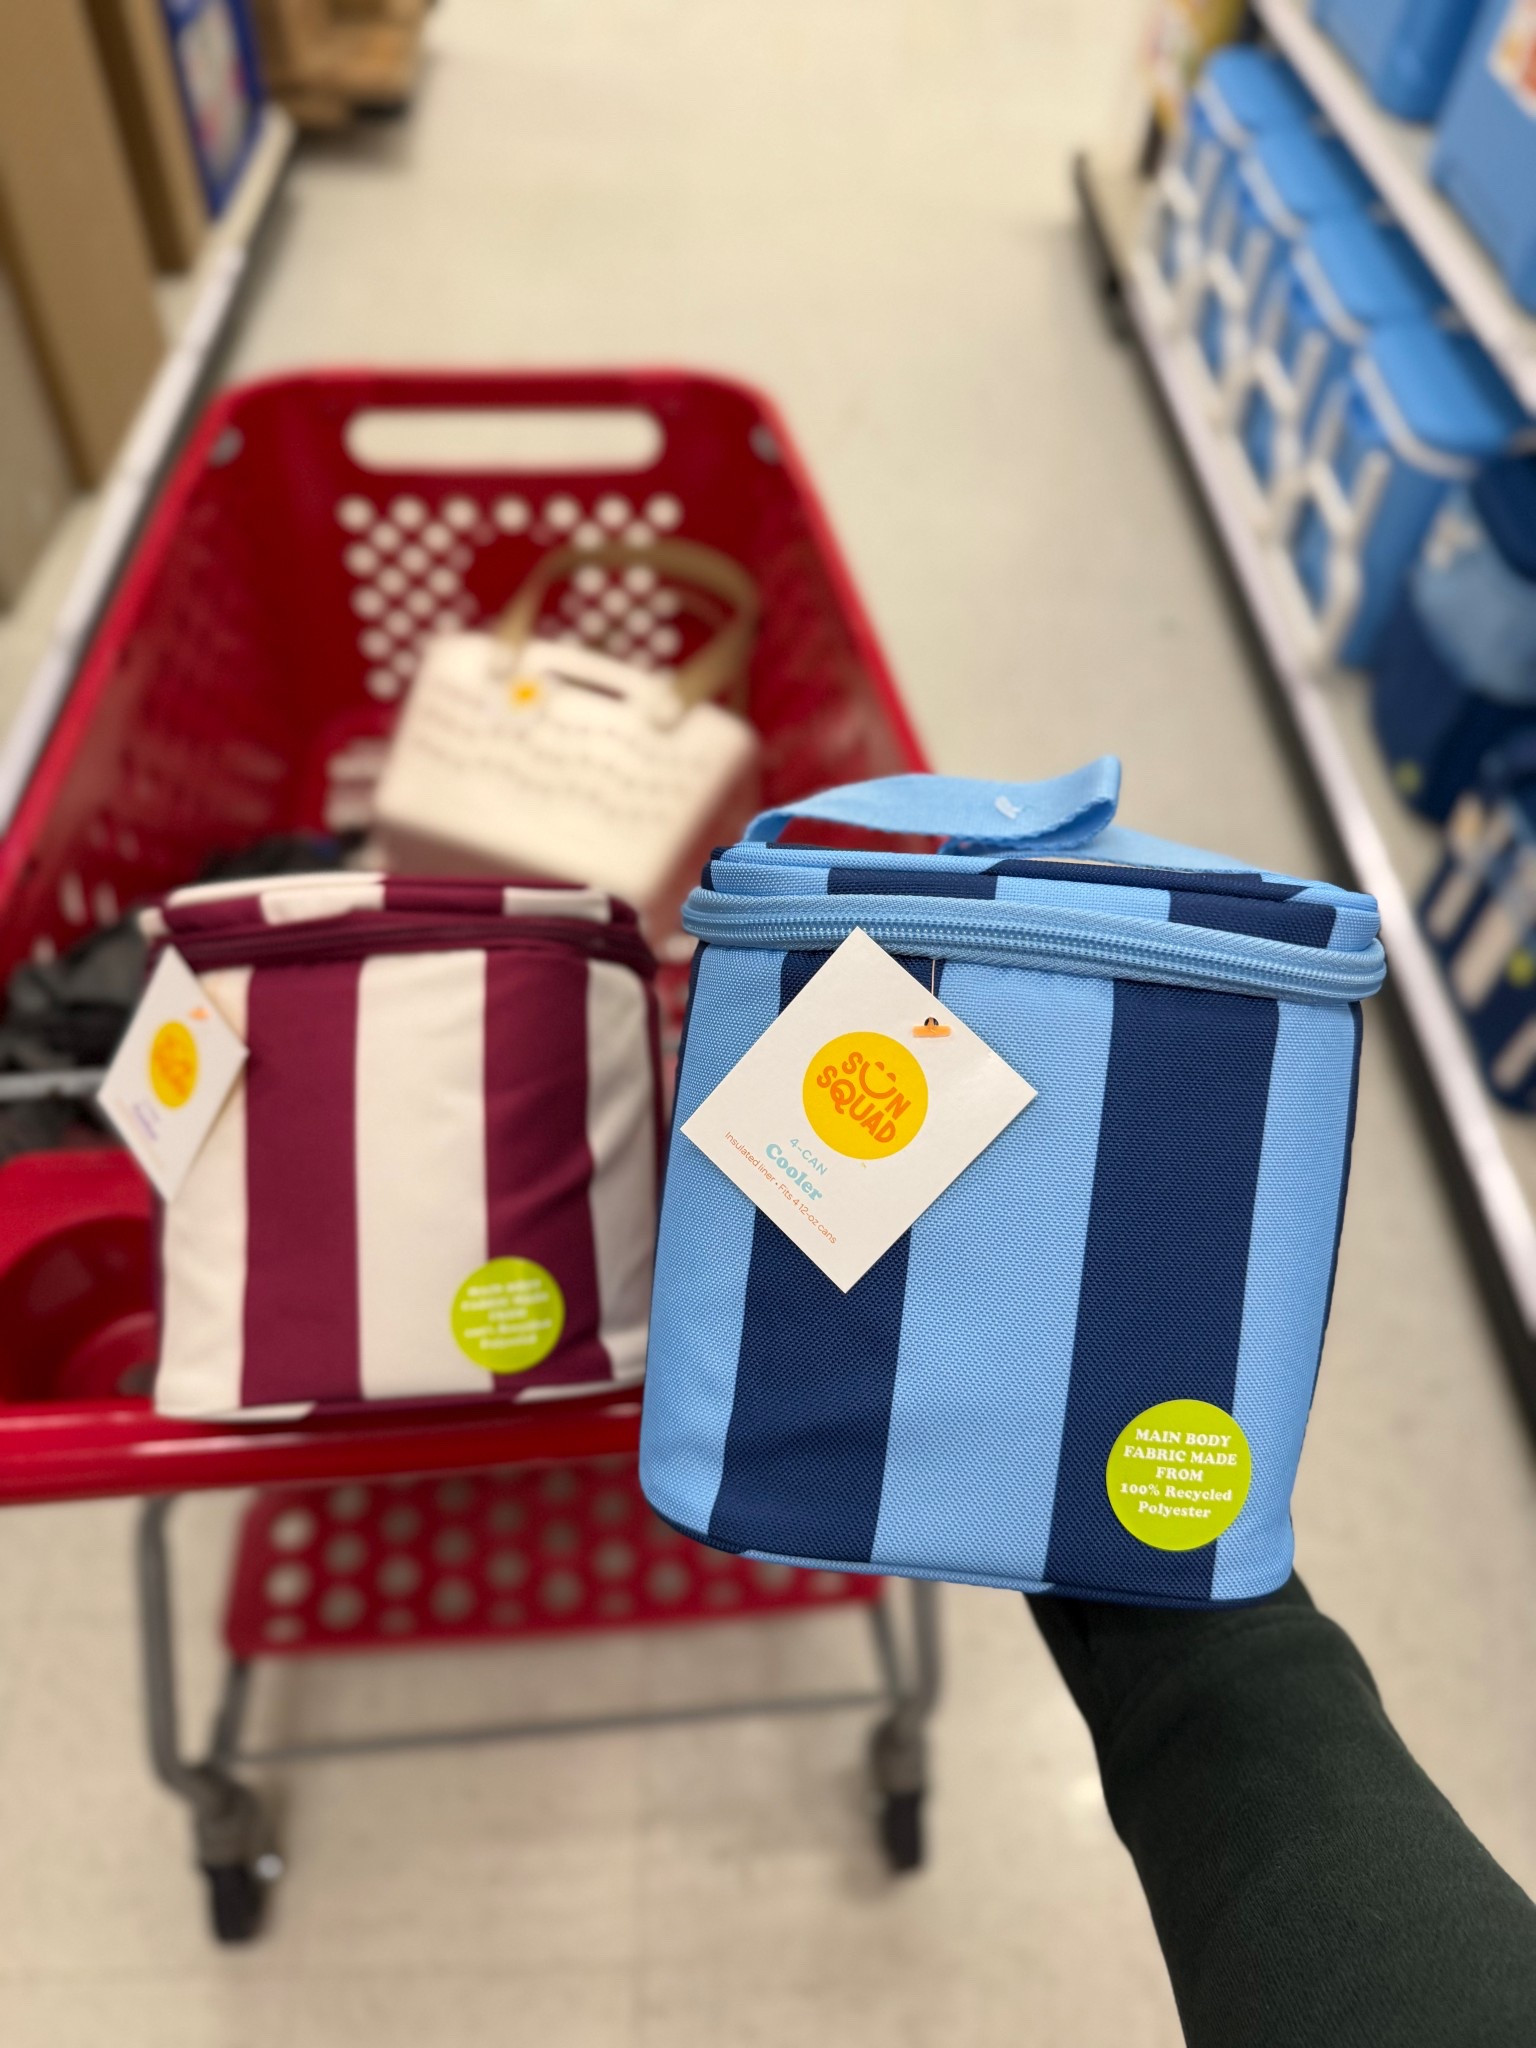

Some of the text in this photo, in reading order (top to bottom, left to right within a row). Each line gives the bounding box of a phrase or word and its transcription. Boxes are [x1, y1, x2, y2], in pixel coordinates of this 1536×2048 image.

[842, 1052, 911, 1120] SUN
[817, 1065, 896, 1143] SQUAD
[790, 1138, 828, 1175] 4-CAN
[766, 1143, 822, 1200] Cooler
[725, 1131, 836, 1244] Insulated liner Fits 4 12-oz cans
[1135, 1428, 1232, 1447] MAIN BODY
[1123, 1445, 1237, 1466] FABRIC MADE
[1155, 1466, 1204, 1482] FROM
[1120, 1482, 1232, 1502] 100% Recycled
[1138, 1501, 1211, 1518] Polyester
